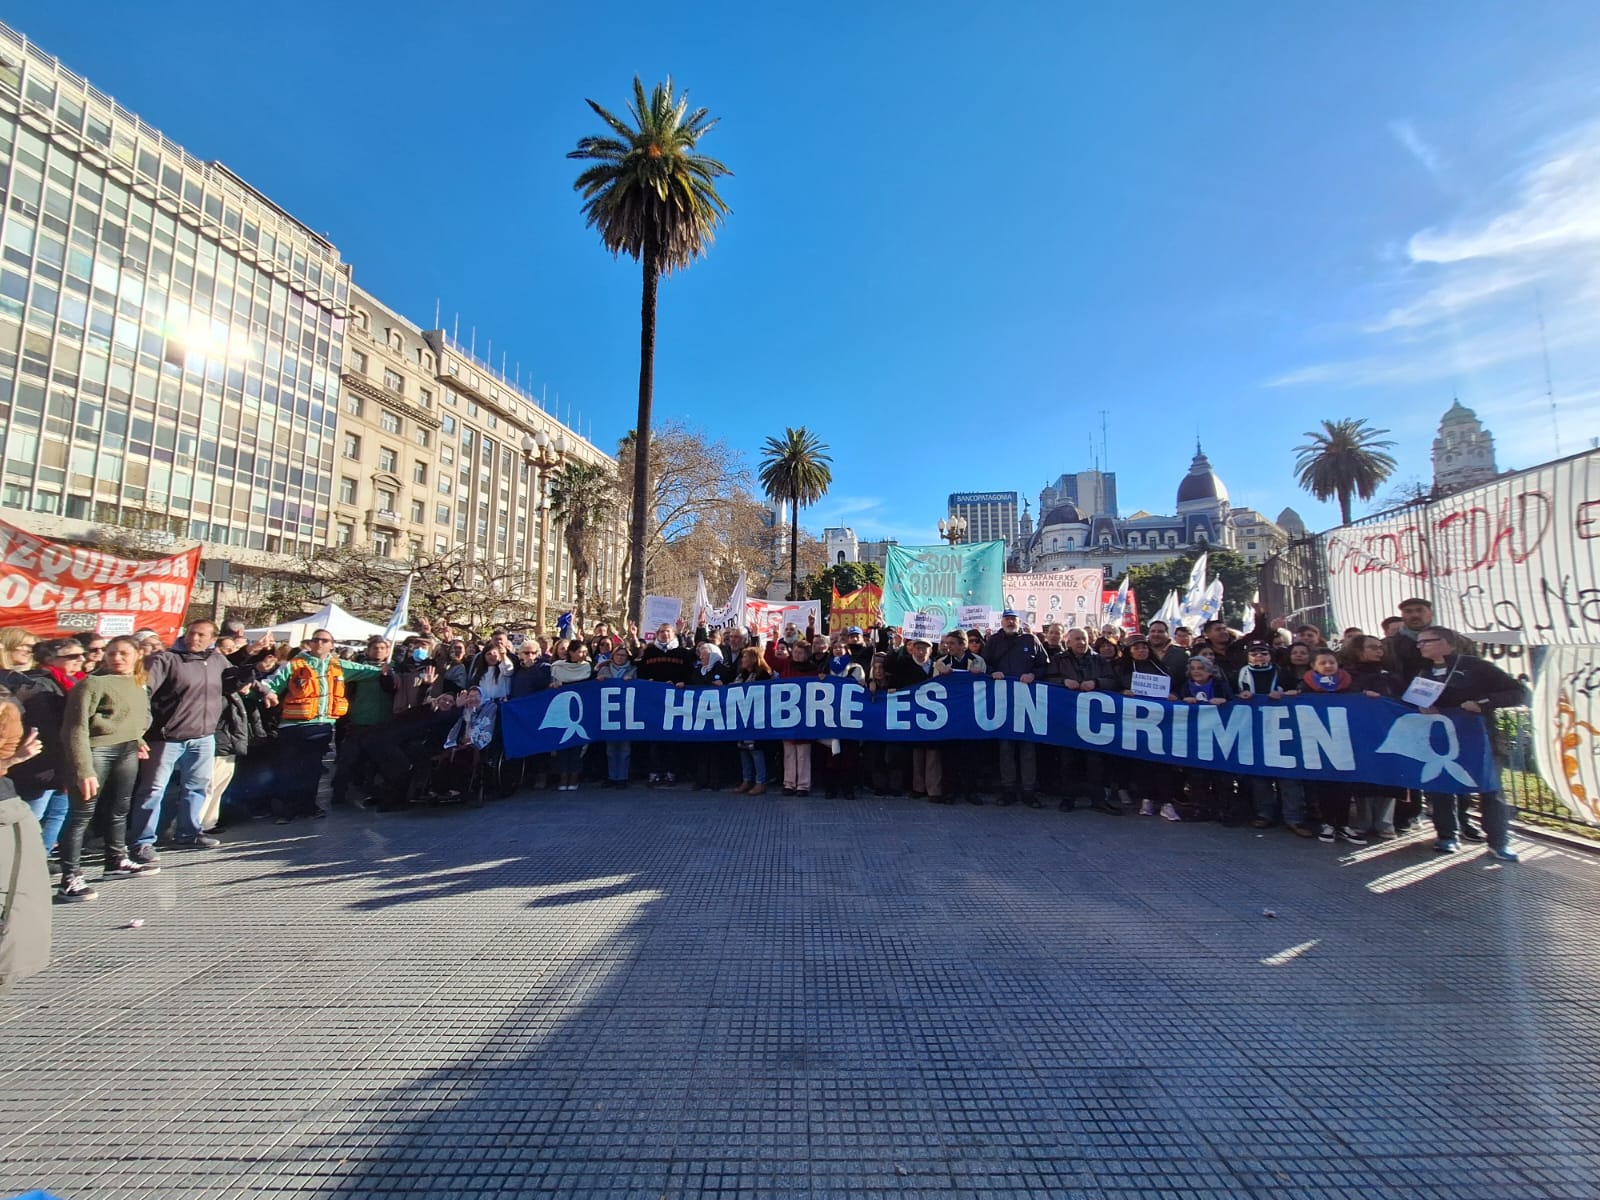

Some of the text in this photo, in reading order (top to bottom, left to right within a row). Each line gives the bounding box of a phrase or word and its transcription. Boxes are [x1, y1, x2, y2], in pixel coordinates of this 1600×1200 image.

[1056, 580, 1078, 588] CRUZ
[600, 679, 1356, 772] EL HAMBRE ES UN CRIMEN
